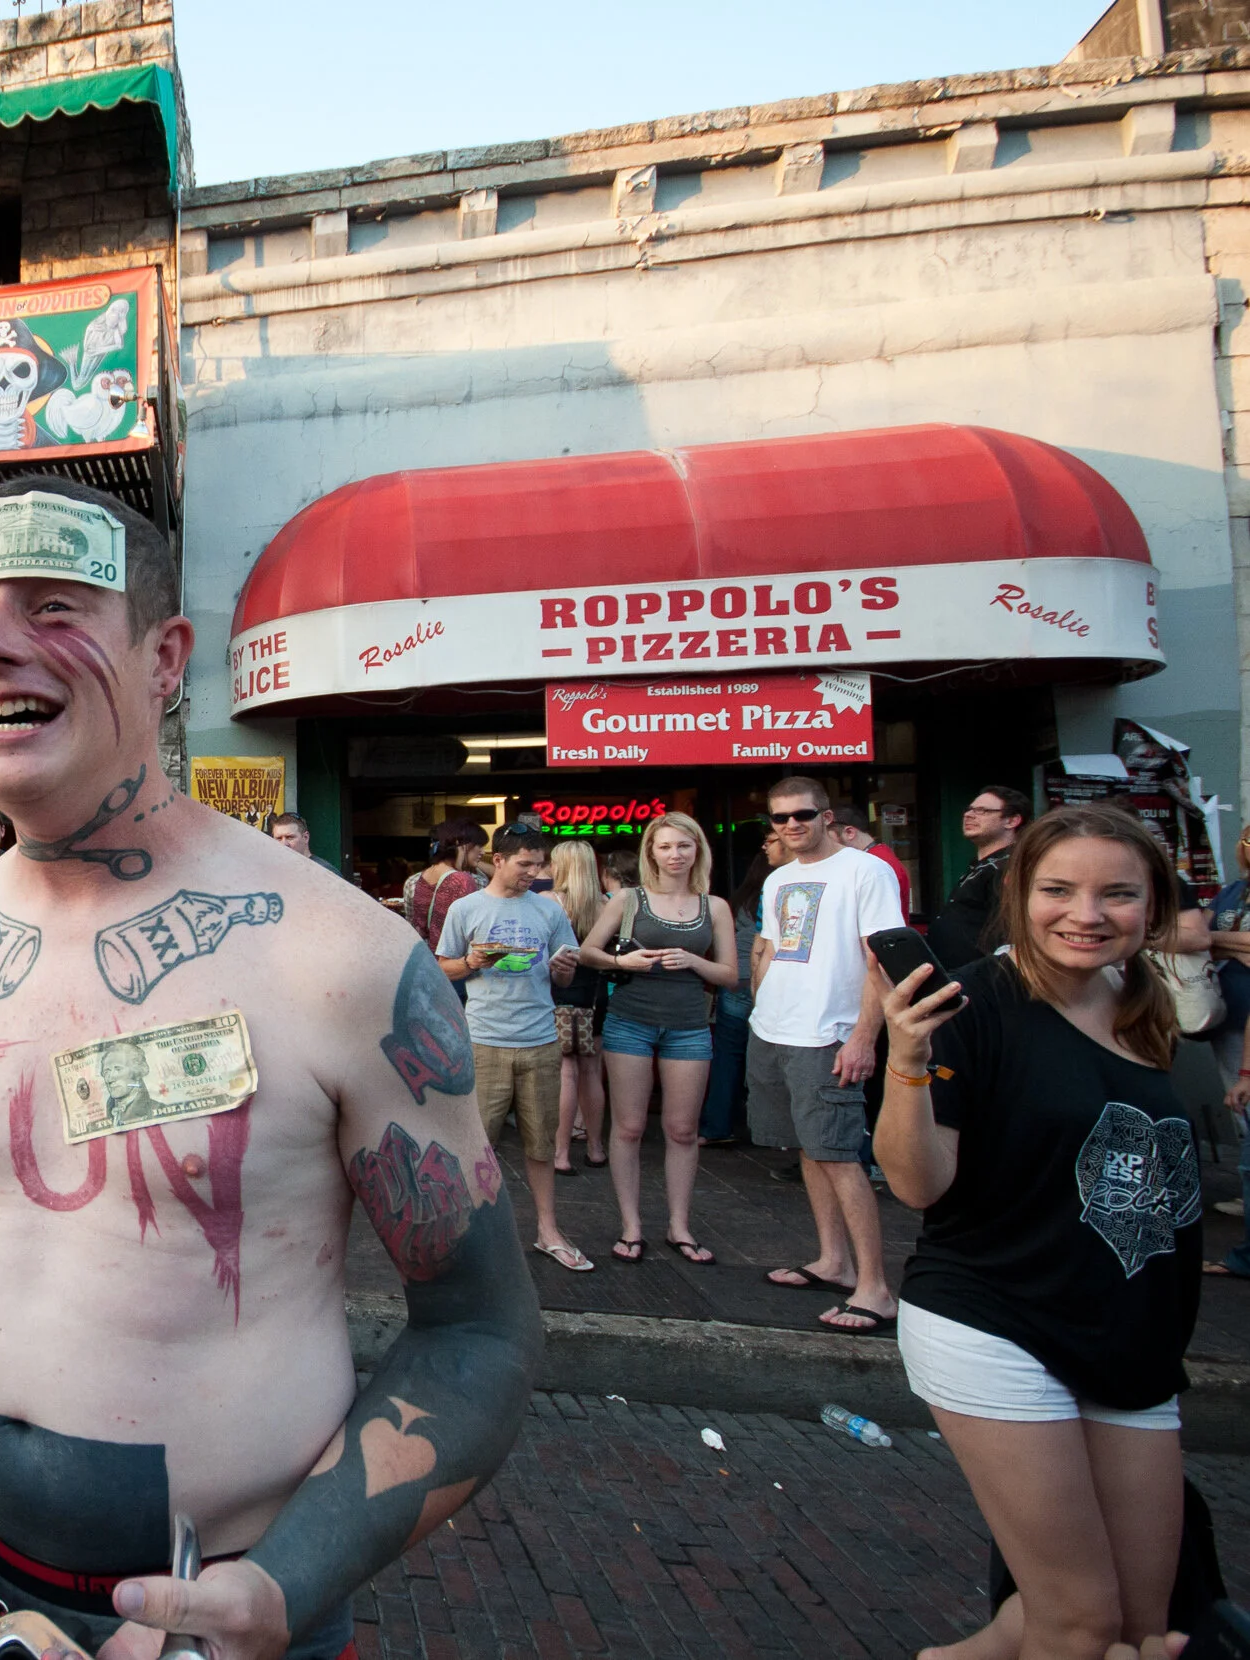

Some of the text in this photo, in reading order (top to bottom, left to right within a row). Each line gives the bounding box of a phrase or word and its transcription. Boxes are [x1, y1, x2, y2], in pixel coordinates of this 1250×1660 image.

[26, 288, 103, 313] ODDITIES
[90, 560, 117, 582] 20
[539, 576, 900, 630] ROPPOLO'S
[989, 583, 1091, 639] Rosalie
[233, 631, 287, 671] BY THE
[359, 619, 446, 675] Rosalie
[586, 622, 852, 665] PIZZERIA
[234, 660, 290, 704] SLICE
[647, 683, 760, 697] Established 1989
[824, 680, 865, 703] Winning
[831, 673, 865, 691] Award
[551, 683, 608, 711] Roppolo's
[582, 704, 834, 734] Gourmet Pizza
[552, 746, 649, 763] Fresh Daily
[732, 742, 868, 760] Family Owned
[195, 768, 223, 779] FOREVER
[224, 768, 238, 779] THE
[239, 768, 266, 779] SICKEST
[197, 779, 280, 799] NEW ALBUM
[213, 799, 250, 813] STORES
[531, 799, 666, 825] Roppolo's
[1159, 809, 1170, 818] IN
[542, 824, 642, 836] PIZZERI
[203, 1028, 235, 1039] STATES
